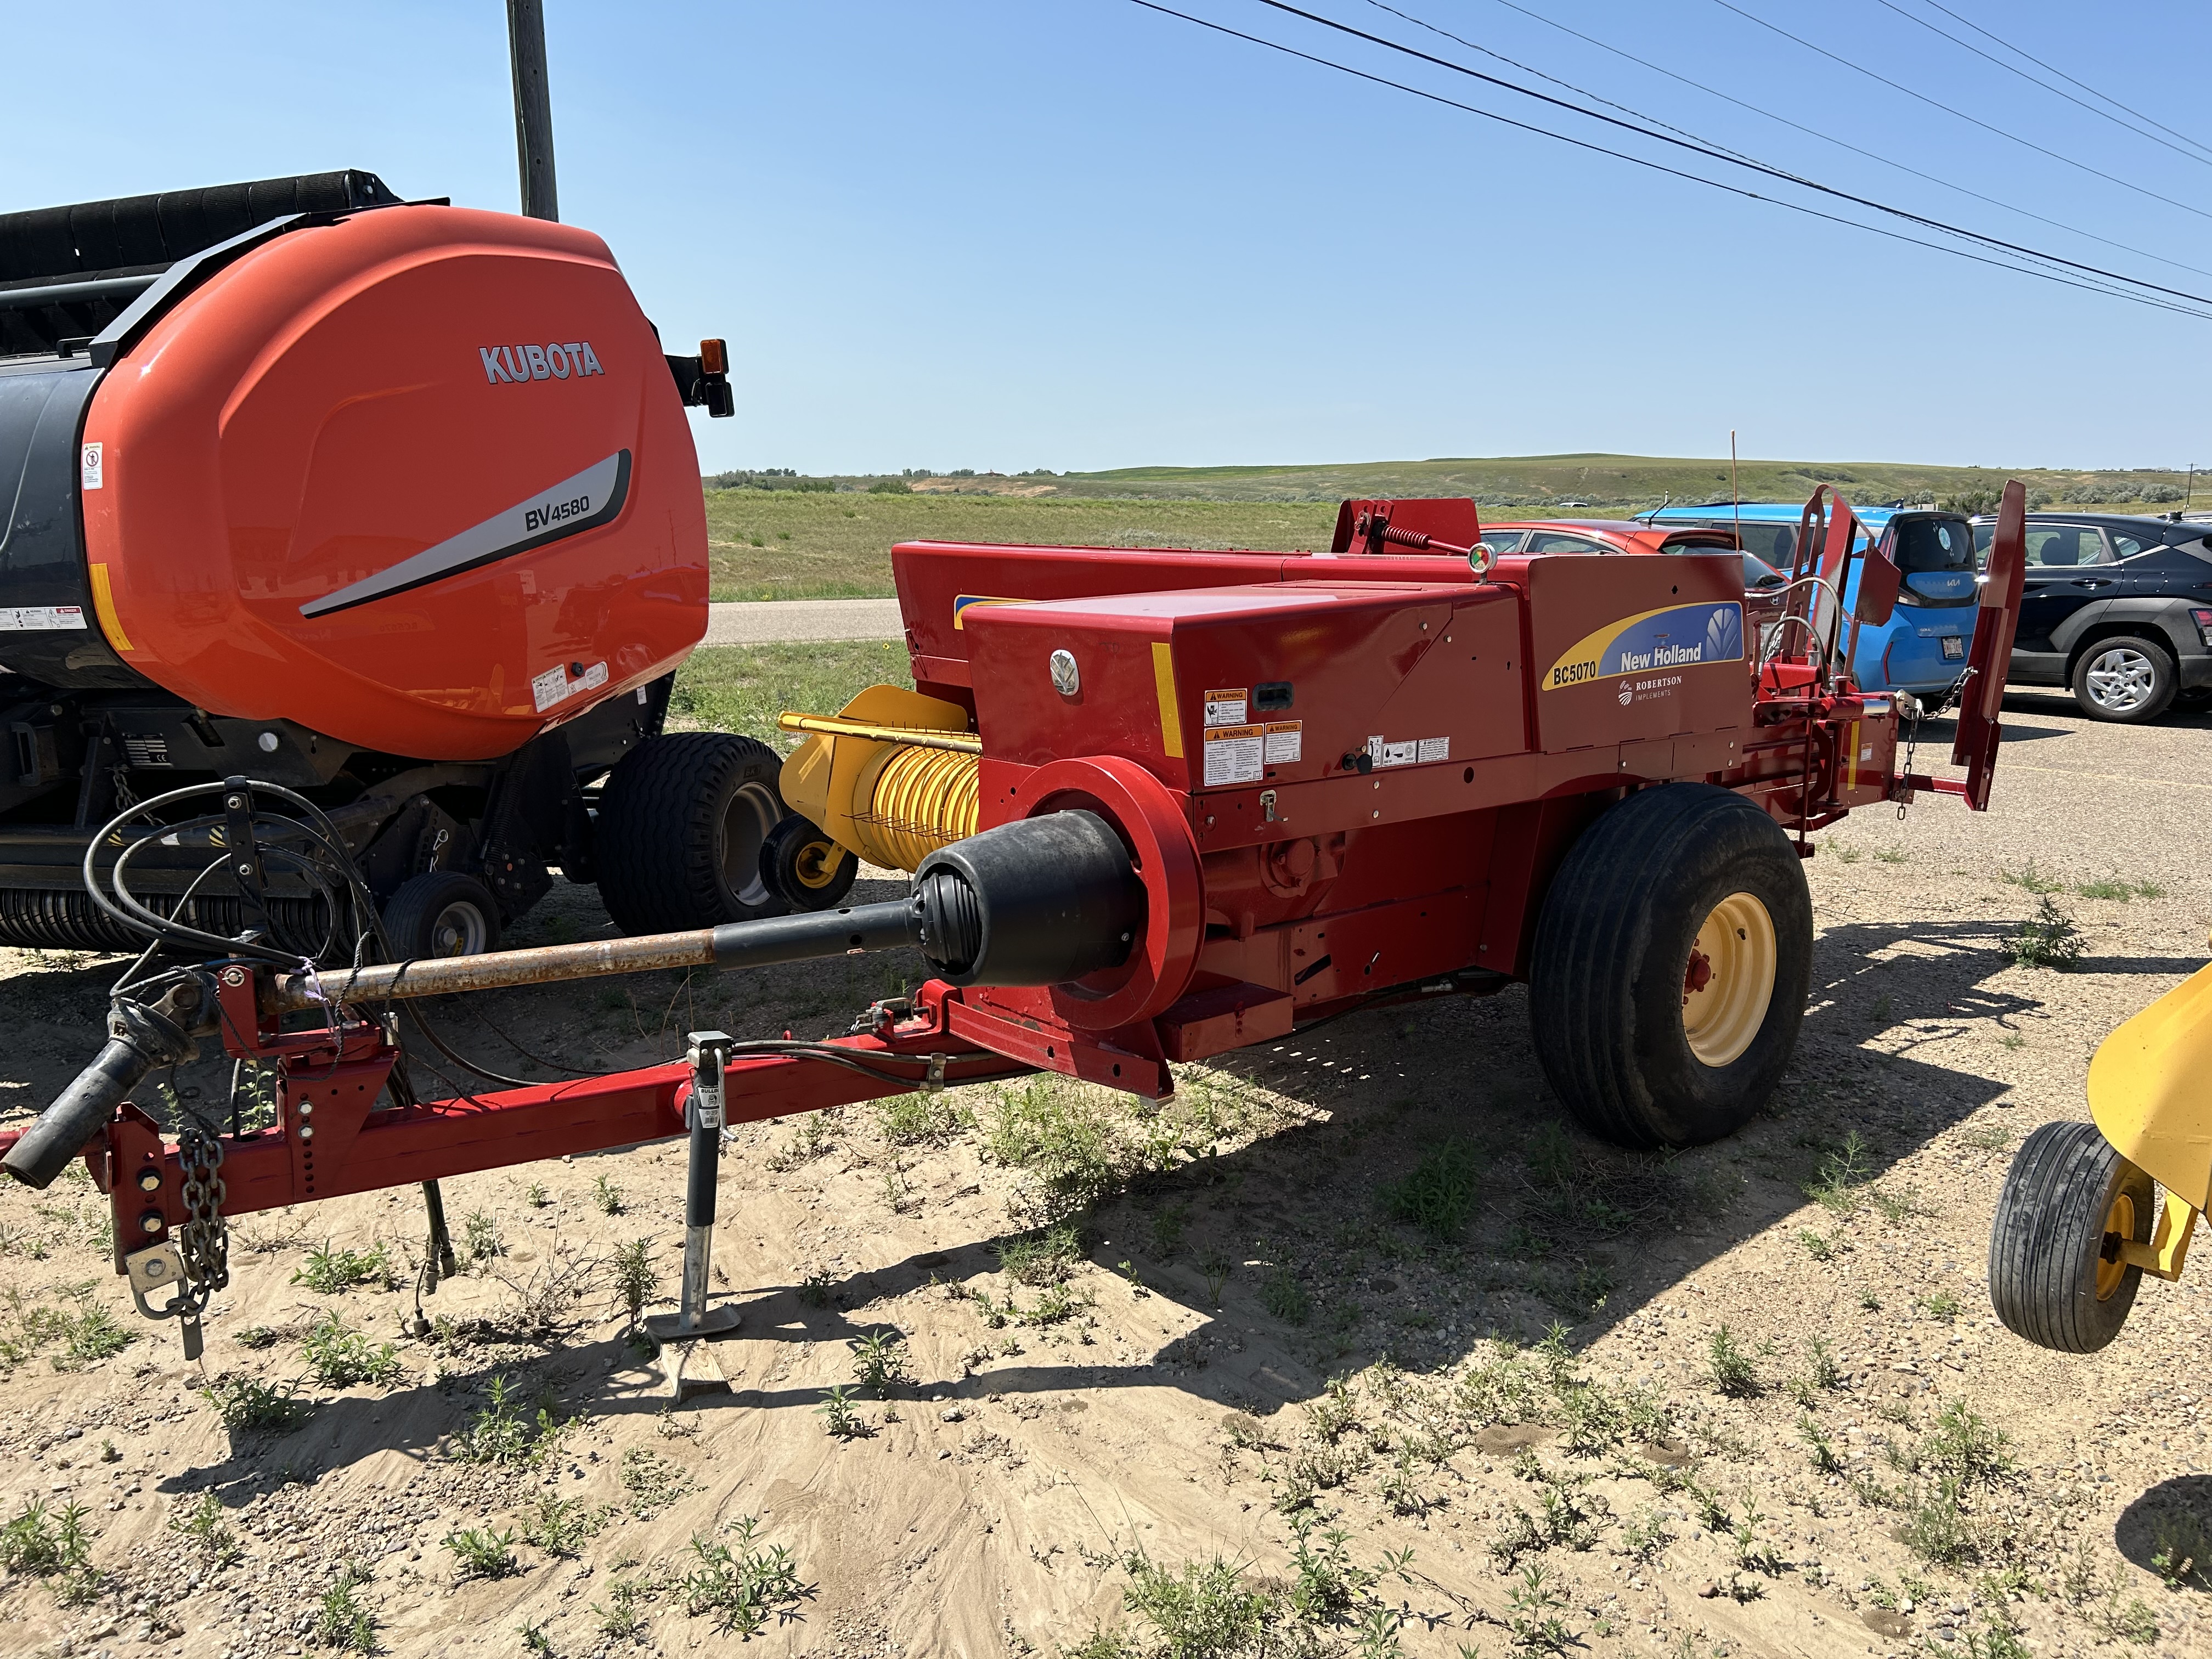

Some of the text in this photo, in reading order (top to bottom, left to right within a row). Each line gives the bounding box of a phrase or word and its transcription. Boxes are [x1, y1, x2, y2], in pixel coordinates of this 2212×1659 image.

[479, 341, 605, 384] KUBOTA
[525, 495, 590, 532] BV4580
[1621, 642, 1702, 672] New Holland
[1554, 661, 1596, 686] BC5070
[1636, 675, 1683, 691] ROBERTSON
[1635, 689, 1671, 702] IMPLEMENTS
[1223, 729, 1254, 738] WARNING
